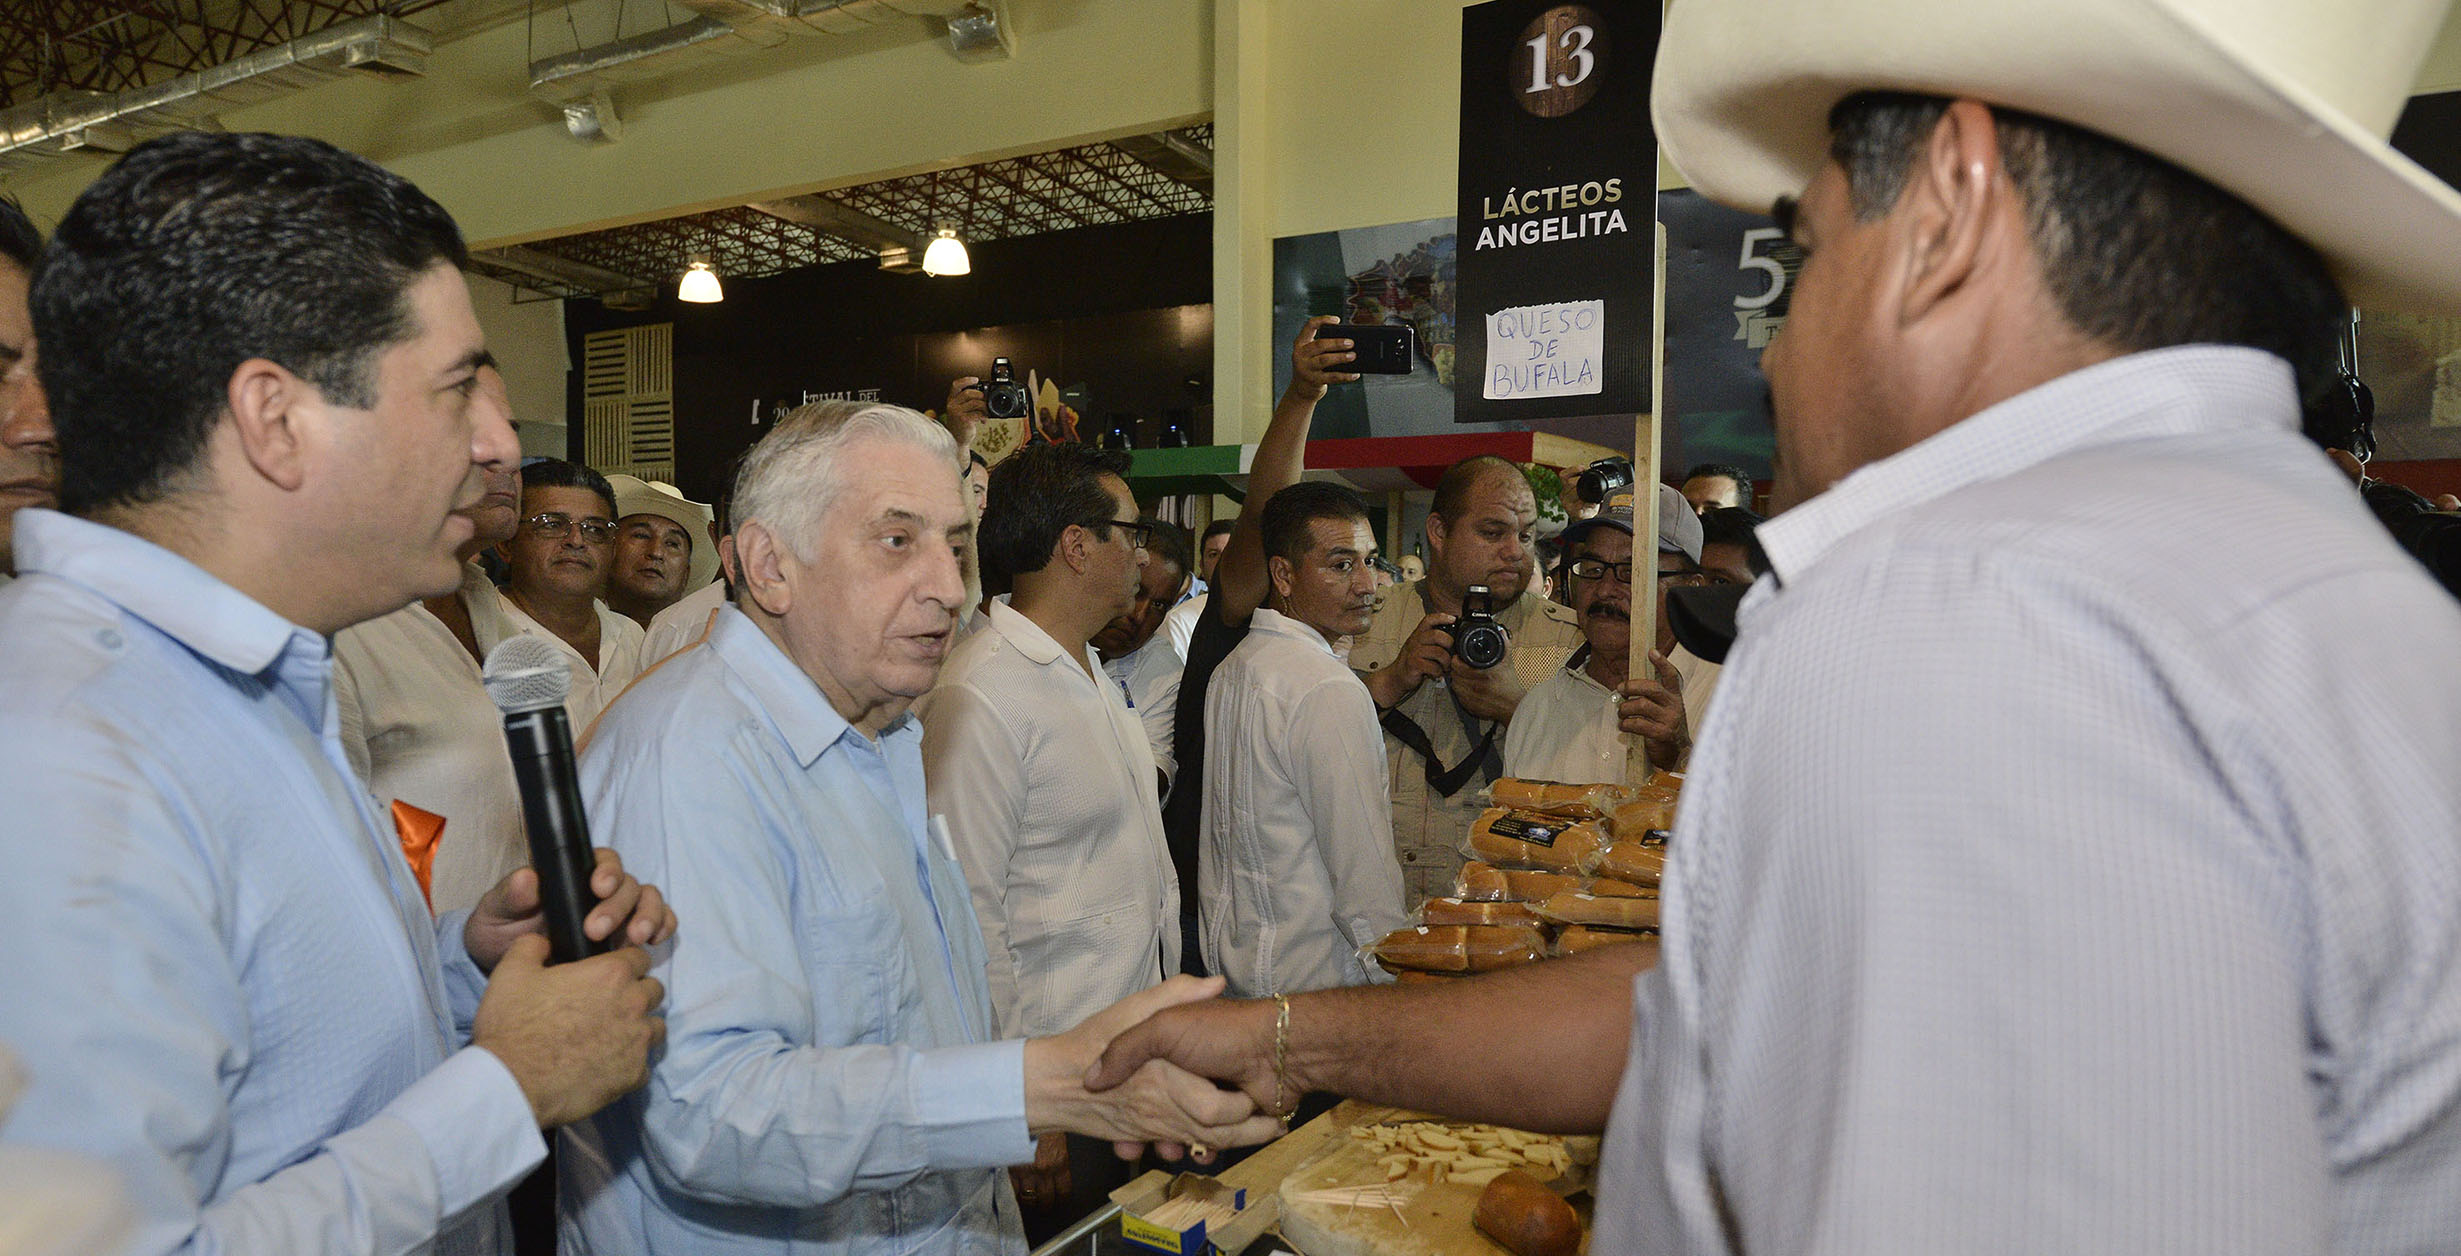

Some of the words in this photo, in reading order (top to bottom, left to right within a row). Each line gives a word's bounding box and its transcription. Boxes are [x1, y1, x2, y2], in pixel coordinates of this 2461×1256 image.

[1526, 25, 1595, 93] 13
[1483, 178, 1623, 220] LÁCTEOS
[1475, 209, 1628, 251] ANGELITA
[1497, 308, 1597, 339] QUESO
[1528, 339, 1559, 361] DE
[805, 391, 852, 403] TIVAL
[1493, 358, 1593, 398] BUFALA
